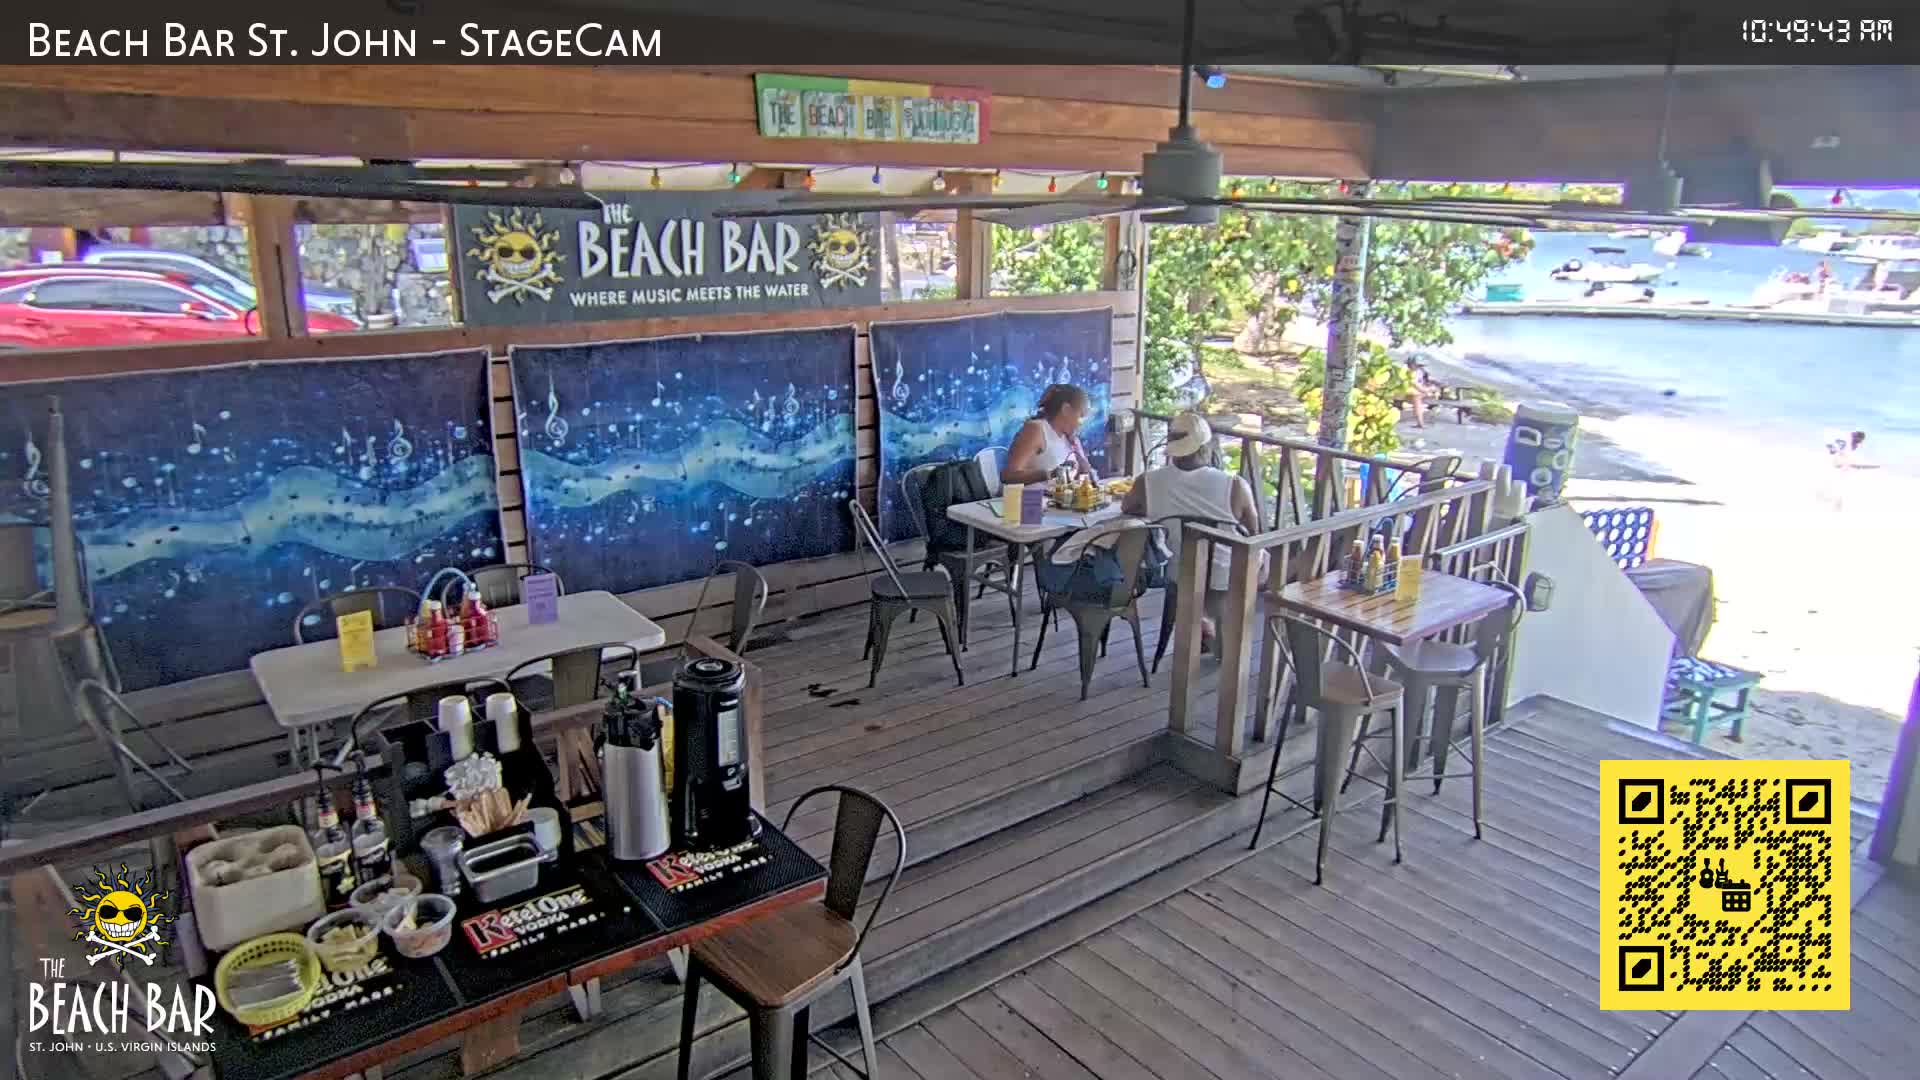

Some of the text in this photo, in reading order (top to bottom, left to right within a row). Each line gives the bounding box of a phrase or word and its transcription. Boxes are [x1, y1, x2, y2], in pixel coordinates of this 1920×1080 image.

[769, 101, 796, 127] THE
[807, 103, 856, 129] BEACH
[602, 202, 634, 224] THE
[578, 218, 801, 279] BEACH BAR
[570, 282, 809, 307] WHERE MUSIC MEETS THE WATER
[512, 911, 569, 936] VODKA
